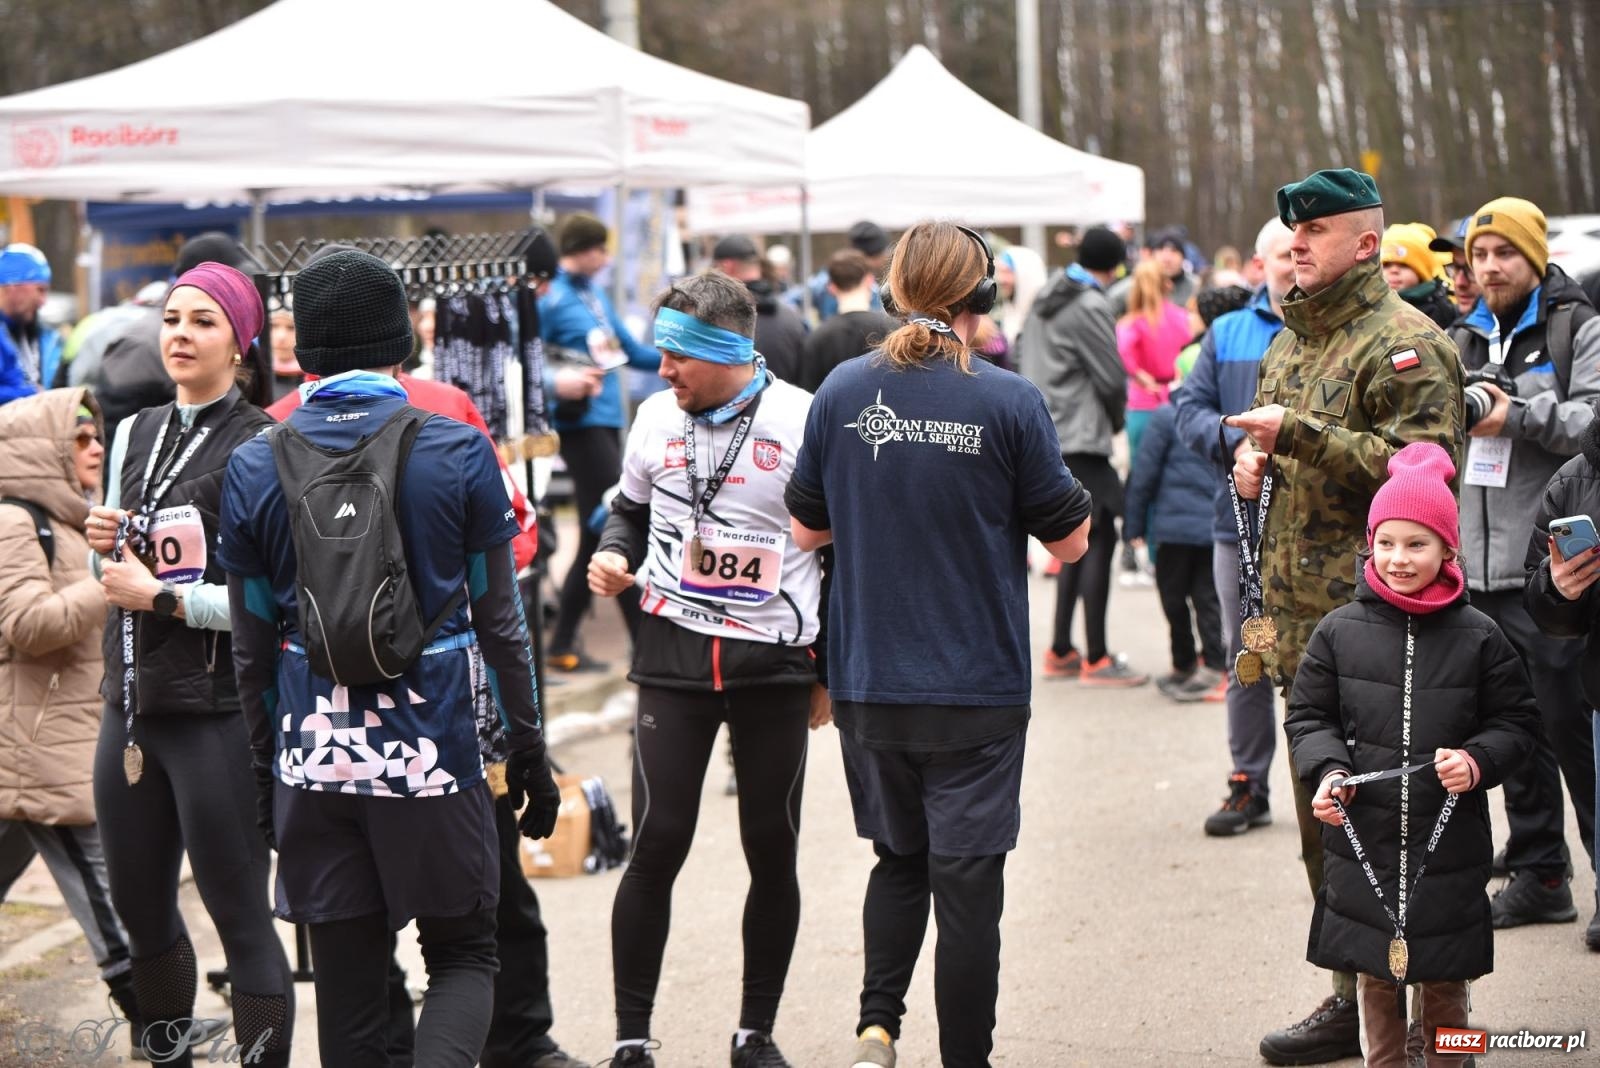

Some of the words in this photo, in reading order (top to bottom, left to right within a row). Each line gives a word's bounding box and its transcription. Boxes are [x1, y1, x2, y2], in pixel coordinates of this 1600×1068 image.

[871, 418, 922, 432] OKTAN
[924, 420, 984, 437] ENERGY
[893, 431, 904, 442] &
[906, 431, 927, 443] V/L
[928, 434, 982, 448] SERVICE
[1227, 473, 1246, 537] TWARDZIELA
[717, 529, 776, 545] Twardziela
[1241, 539, 1252, 563] BIEG
[699, 549, 762, 583] 084
[1404, 668, 1412, 695] COOL
[1403, 694, 1411, 709] SO
[1403, 709, 1411, 720] IS
[1403, 720, 1411, 746] LOVE
[1428, 792, 1459, 852] 23.02.2025
[1362, 861, 1379, 886] BIEG
